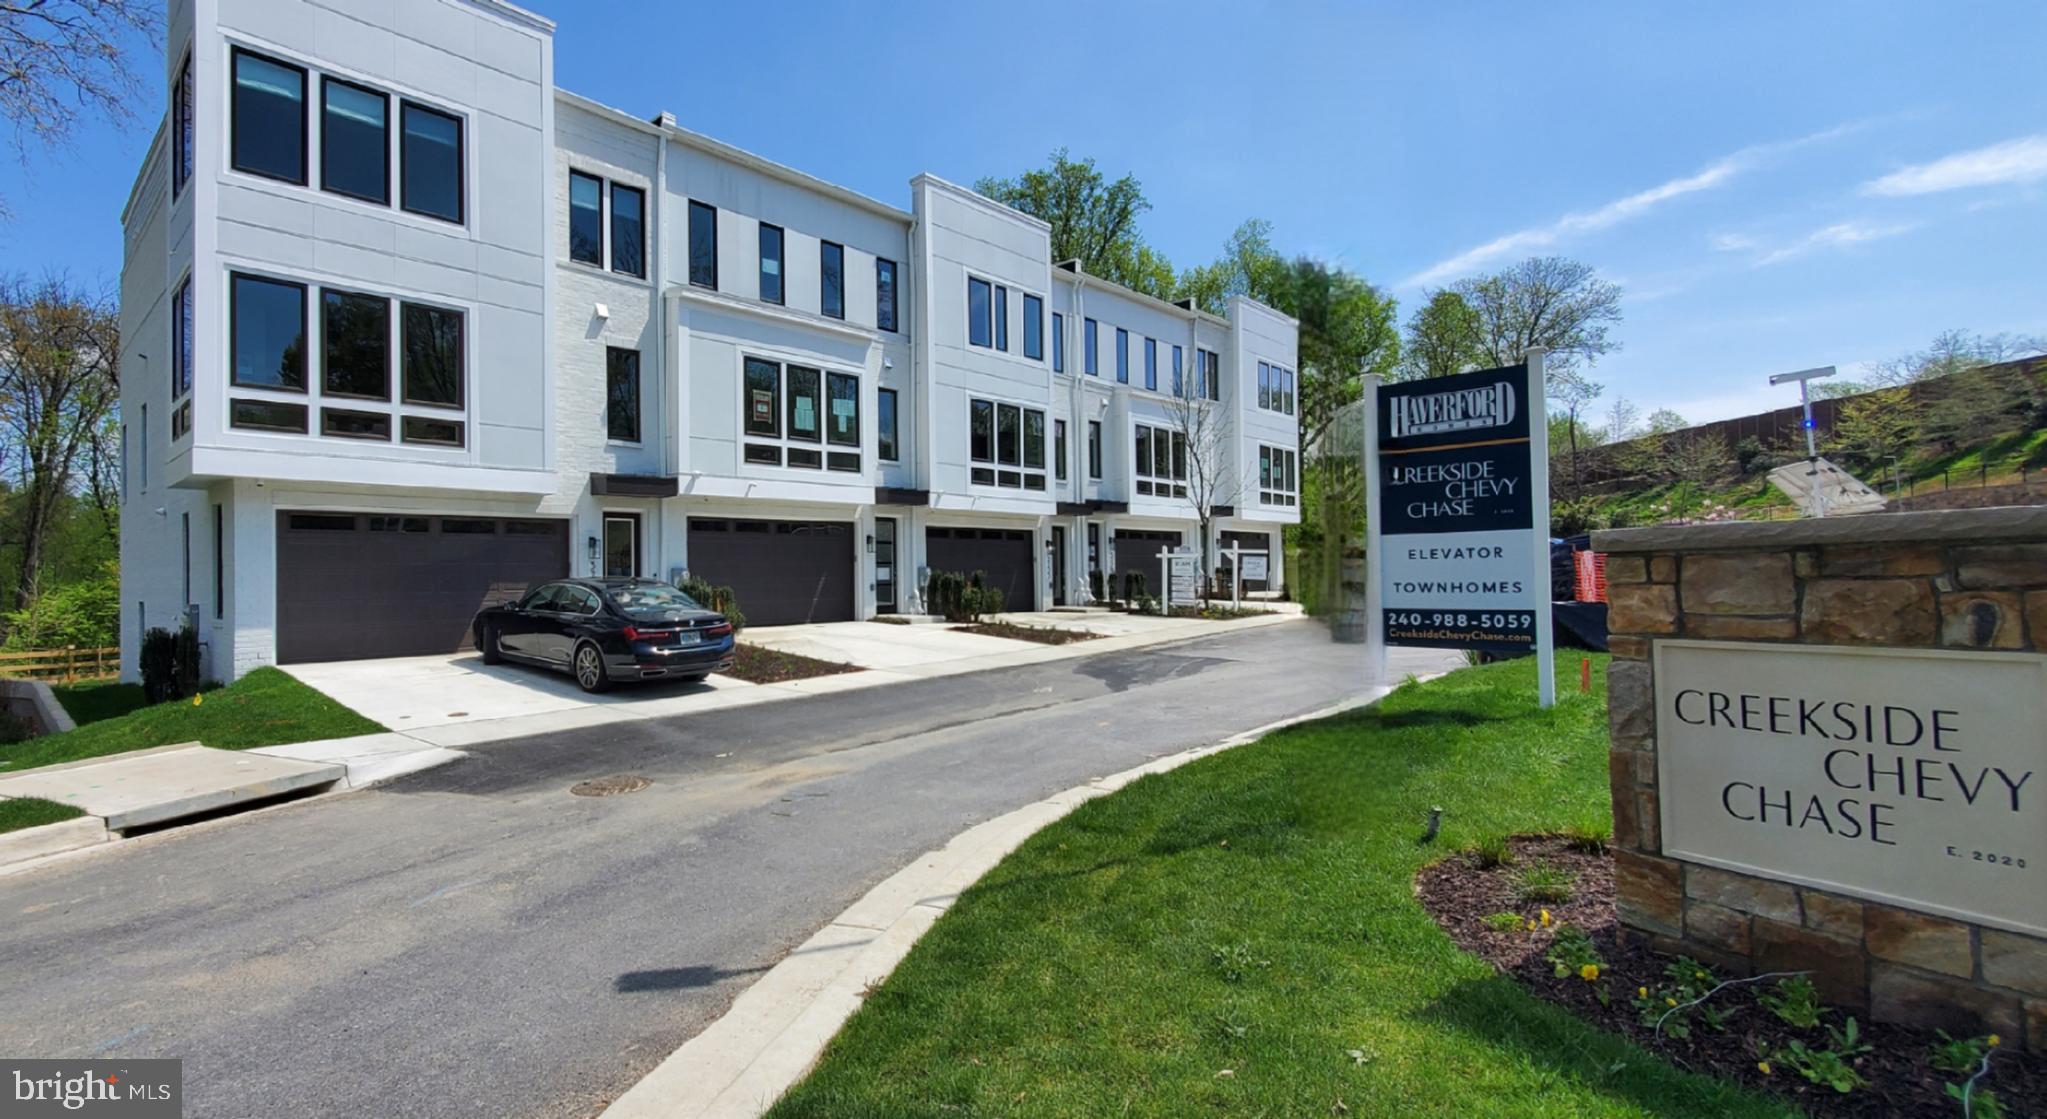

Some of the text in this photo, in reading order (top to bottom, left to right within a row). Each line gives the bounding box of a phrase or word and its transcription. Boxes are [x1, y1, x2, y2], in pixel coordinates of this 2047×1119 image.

[1390, 381, 1516, 438] HAVERFORD
[1445, 477, 1519, 499] CHEVY
[1407, 499, 1475, 519] CHASE
[1408, 546, 1504, 560] ELEVATOR
[1393, 581, 1523, 594] TOWNHOMES
[1388, 612, 1532, 629] 240-988-5059
[1674, 689, 1961, 753] CREEKSIDE
[1823, 749, 2033, 813] CHEVY
[1721, 781, 1898, 846] CHASE
[1946, 845, 2027, 869] E. 2020
